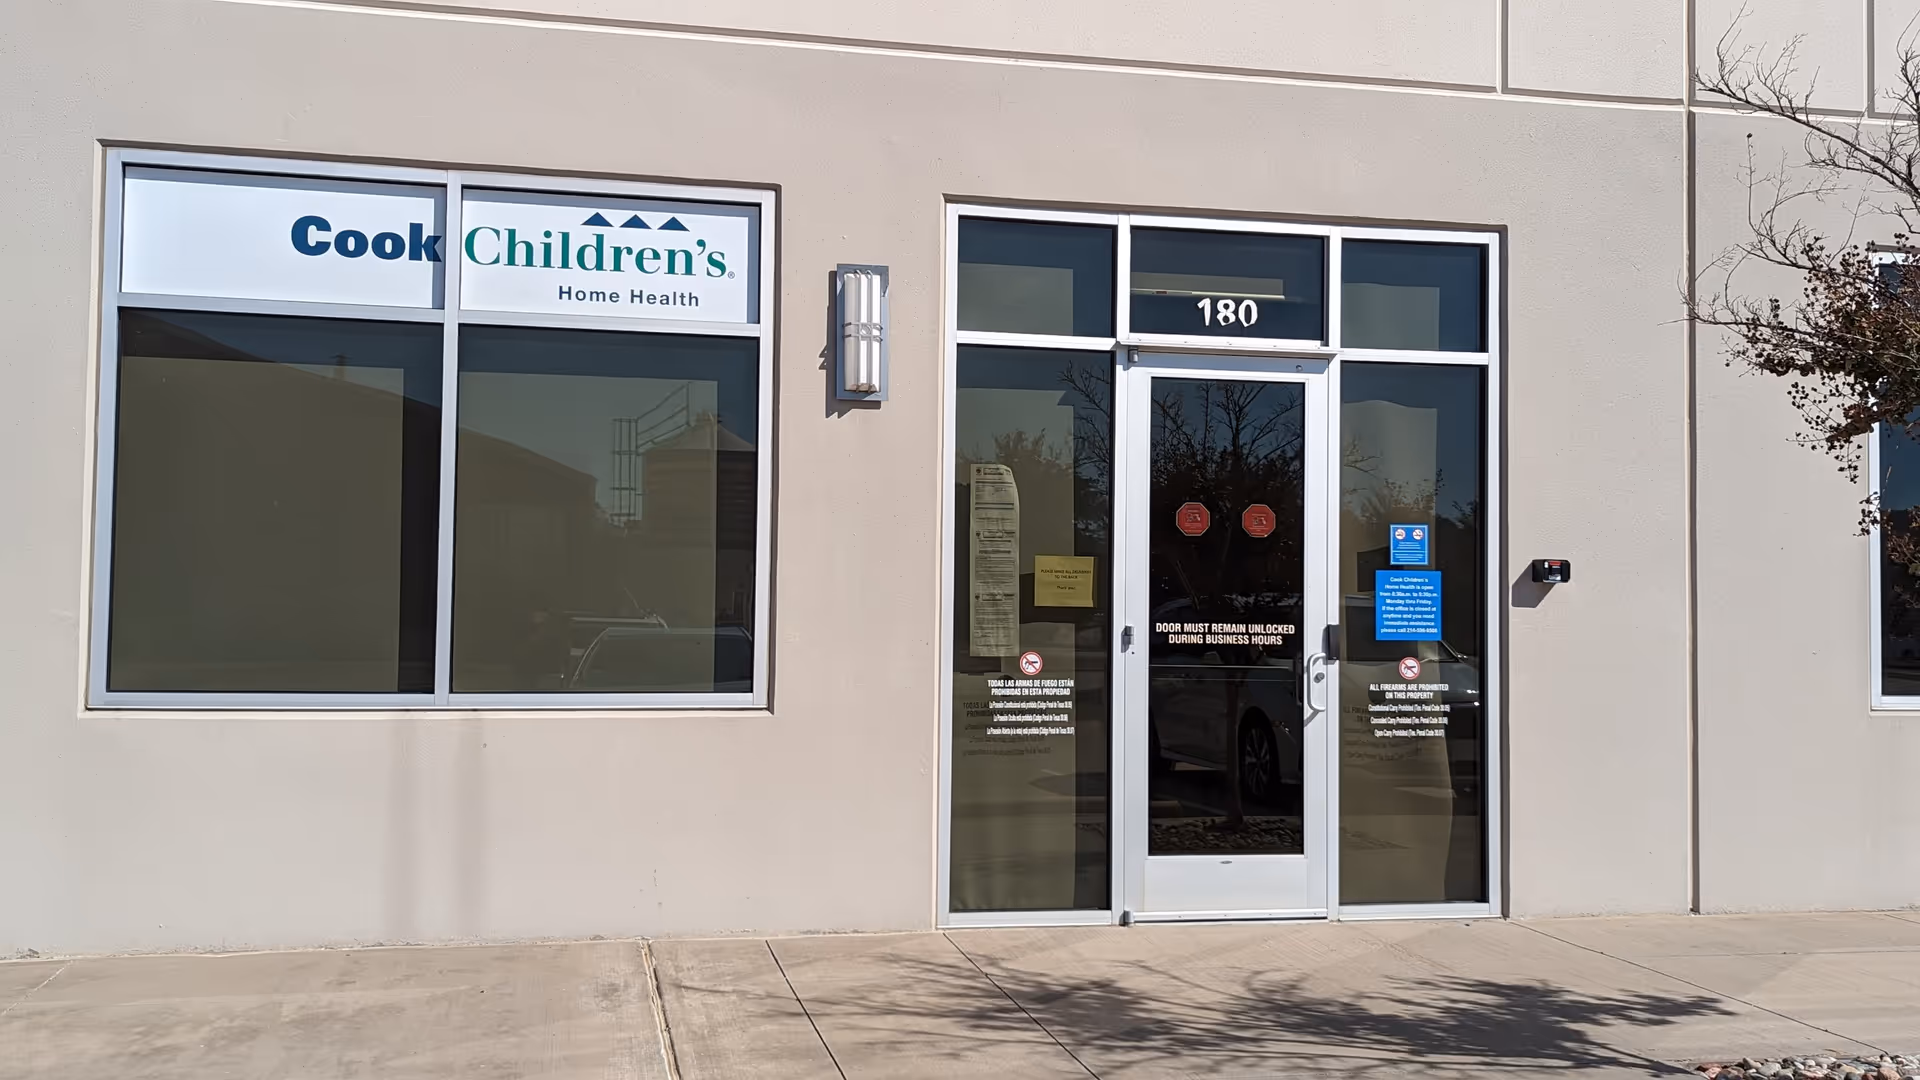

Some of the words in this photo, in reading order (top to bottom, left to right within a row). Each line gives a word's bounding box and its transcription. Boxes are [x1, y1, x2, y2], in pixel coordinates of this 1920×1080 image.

[291, 215, 442, 262] Cook
[464, 226, 727, 278] Children's
[559, 285, 620, 303] Home
[630, 289, 700, 307] Health
[1197, 298, 1258, 327] 180
[1155, 622, 1182, 633] DOOR
[1183, 623, 1209, 633] MUST
[1211, 623, 1246, 634] REMAIN
[1248, 624, 1295, 634] UNLOCKED
[1168, 634, 1203, 644] DURING
[1205, 634, 1249, 645] BUSINESS
[1251, 635, 1283, 645] HOURS
[988, 679, 1004, 687] TODAS
[1005, 679, 1014, 687] LAS
[1015, 679, 1033, 687] ARMAS
[1034, 679, 1040, 687] DE
[1041, 679, 1057, 687] FUEGO
[1369, 683, 1379, 691] ALL
[1380, 683, 1406, 691] FIREARMS
[1407, 683, 1417, 691] ARE
[1419, 683, 1449, 691] PROHIBITED
